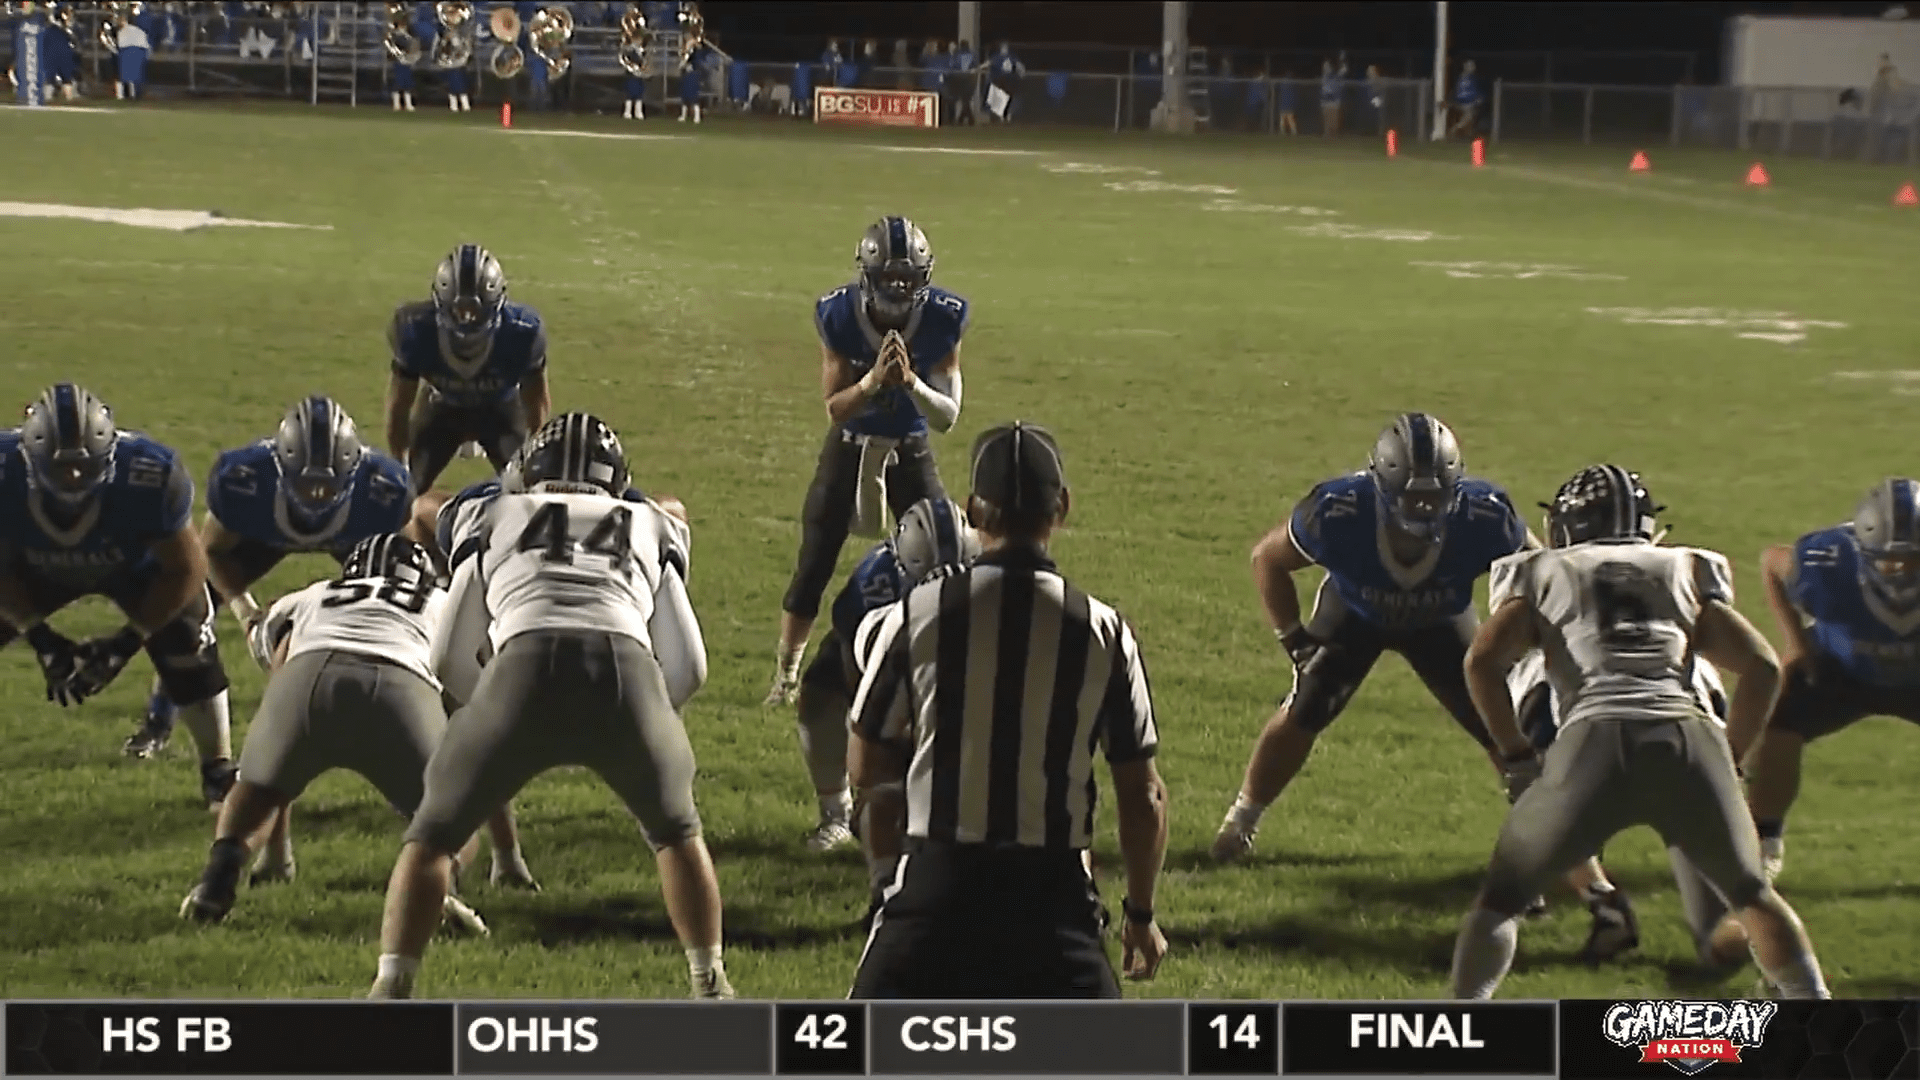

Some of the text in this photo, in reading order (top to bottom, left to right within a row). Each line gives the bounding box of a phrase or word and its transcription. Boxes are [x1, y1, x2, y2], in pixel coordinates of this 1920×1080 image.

[820, 94, 881, 114] BGSU
[907, 95, 933, 127] #1
[517, 502, 634, 577] 44
[321, 577, 427, 614] 58
